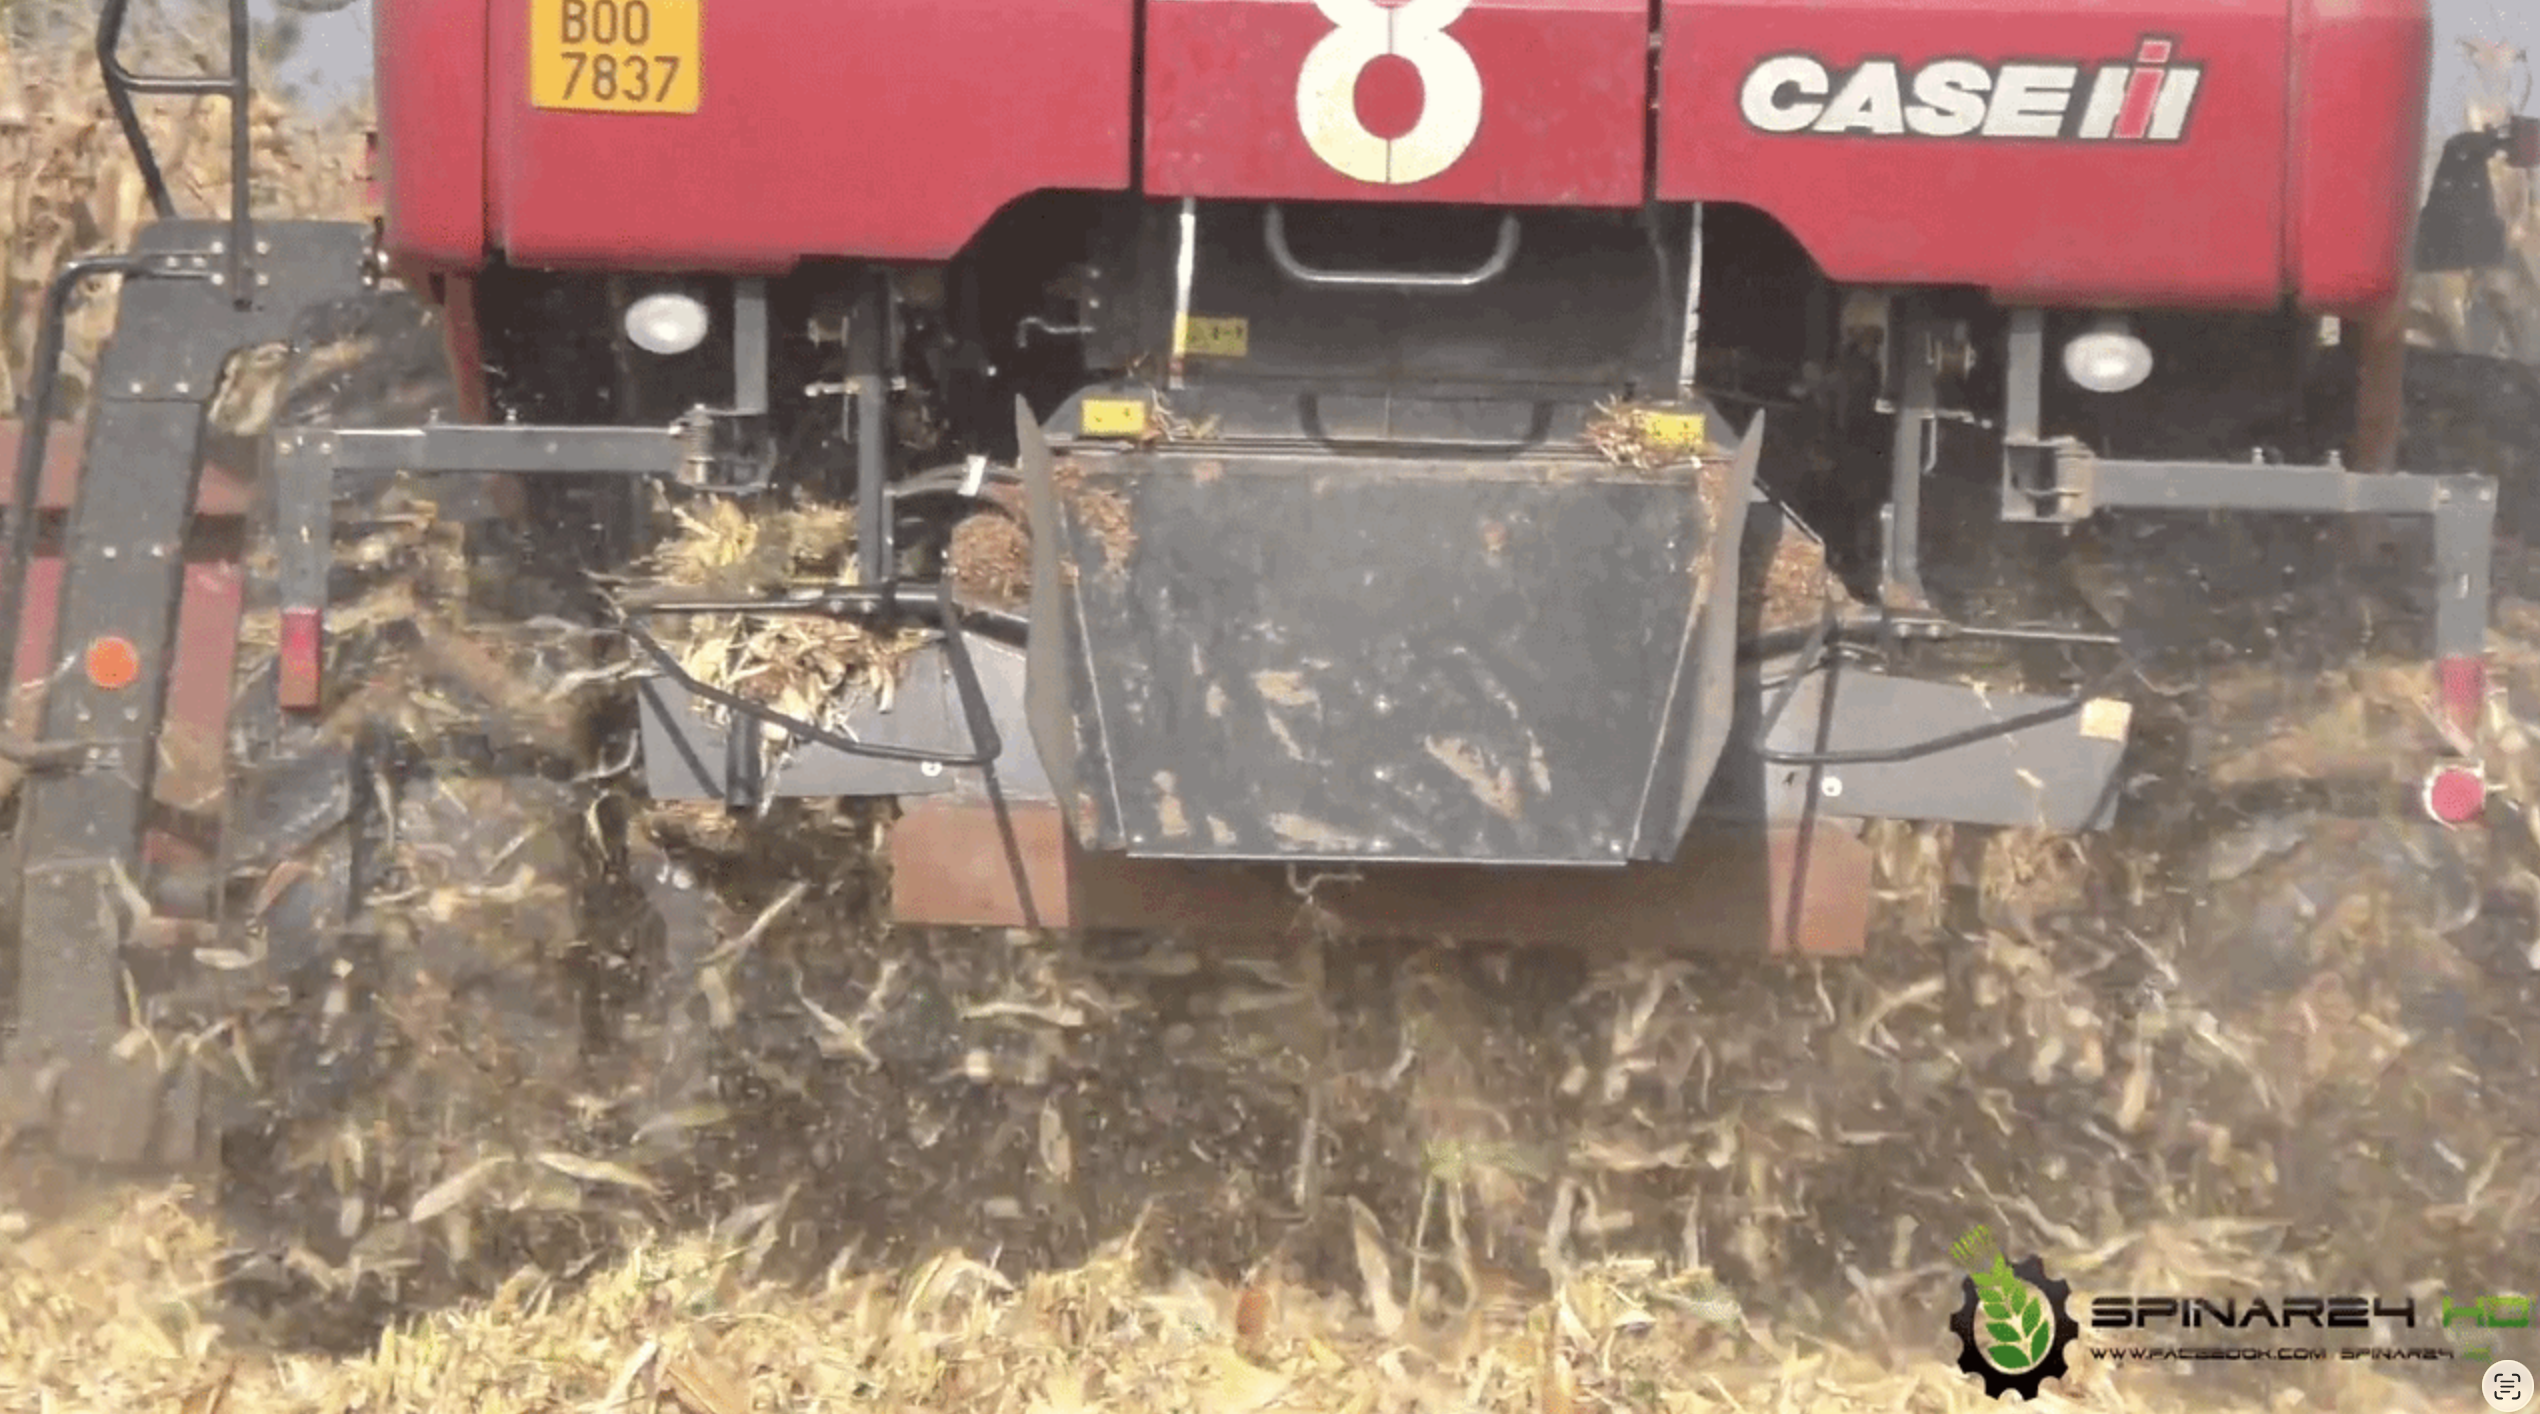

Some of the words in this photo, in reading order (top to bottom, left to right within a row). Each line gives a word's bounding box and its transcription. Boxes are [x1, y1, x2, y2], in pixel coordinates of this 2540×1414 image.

[561, 52, 680, 102] 7837
[1296, 0, 1483, 184] 8
[1741, 55, 2078, 137] CASE
